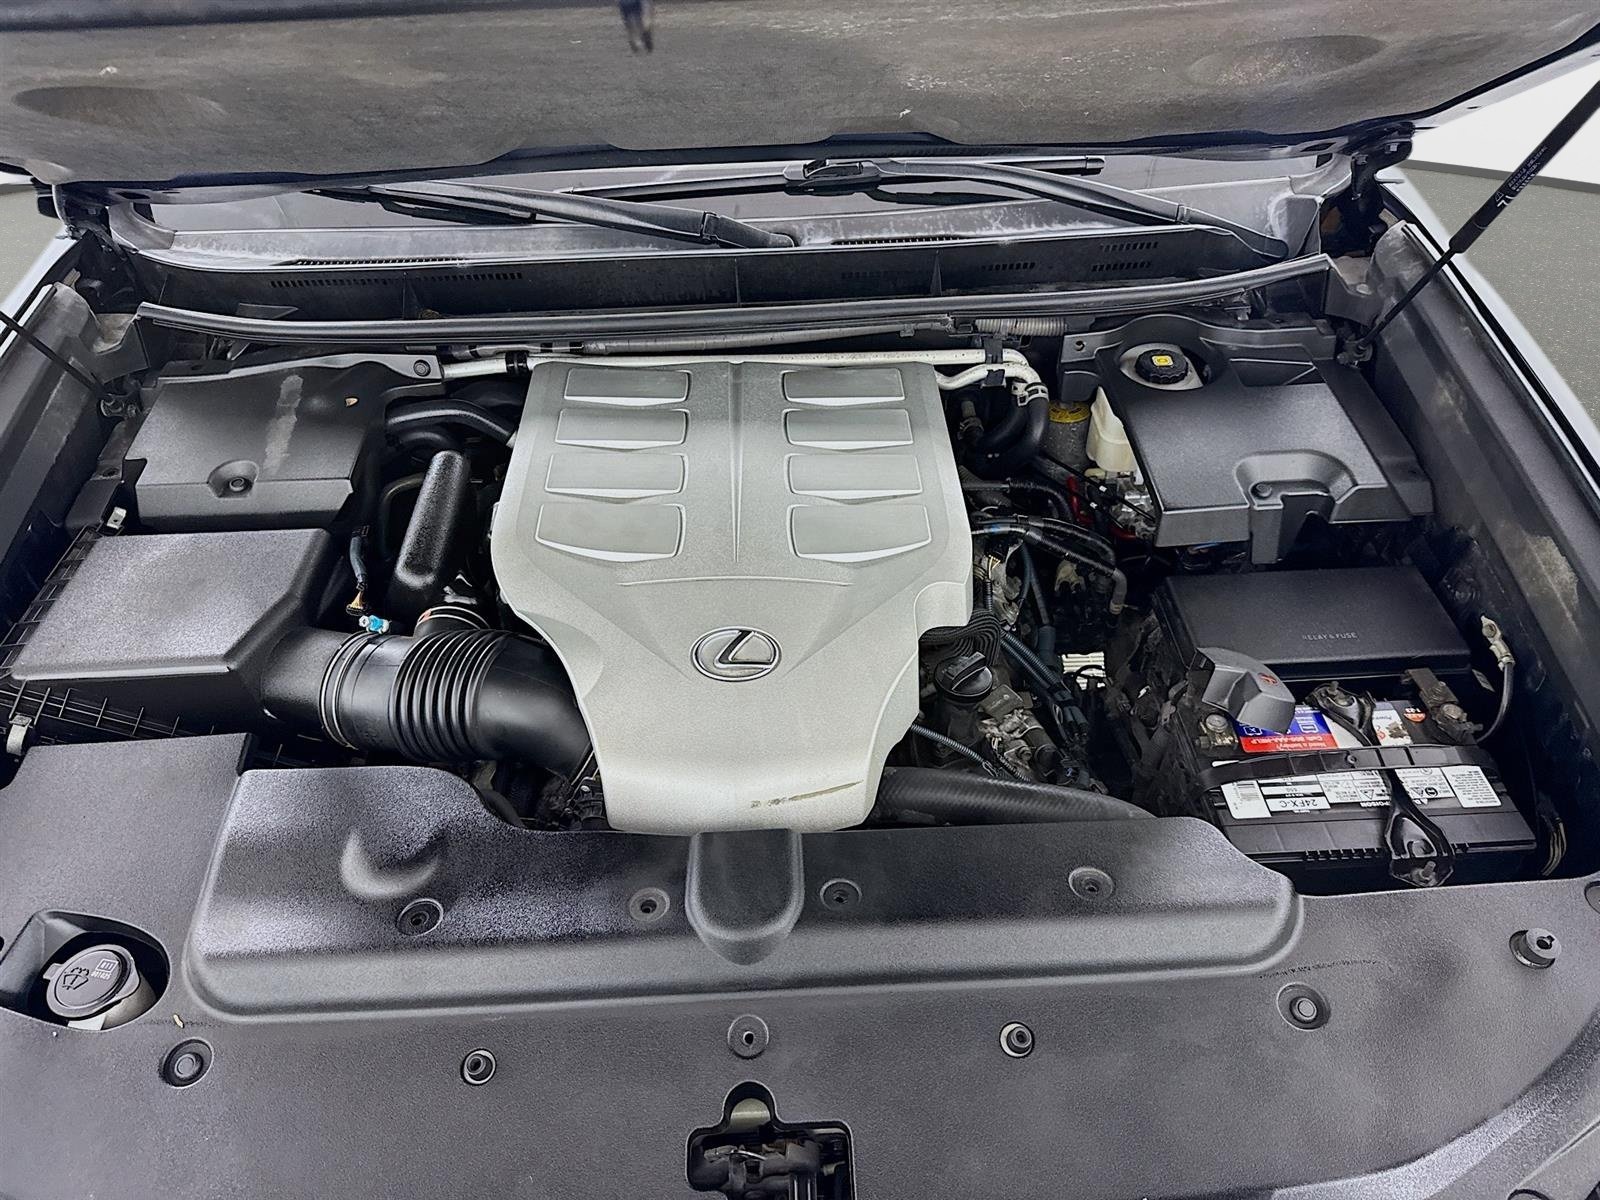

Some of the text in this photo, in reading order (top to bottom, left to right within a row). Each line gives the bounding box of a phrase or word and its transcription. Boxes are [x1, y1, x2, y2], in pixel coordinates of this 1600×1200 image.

[1302, 633, 1328, 641] RELAY
[1335, 632, 1358, 640] FUSE
[1279, 798, 1318, 809] 24FX-C
